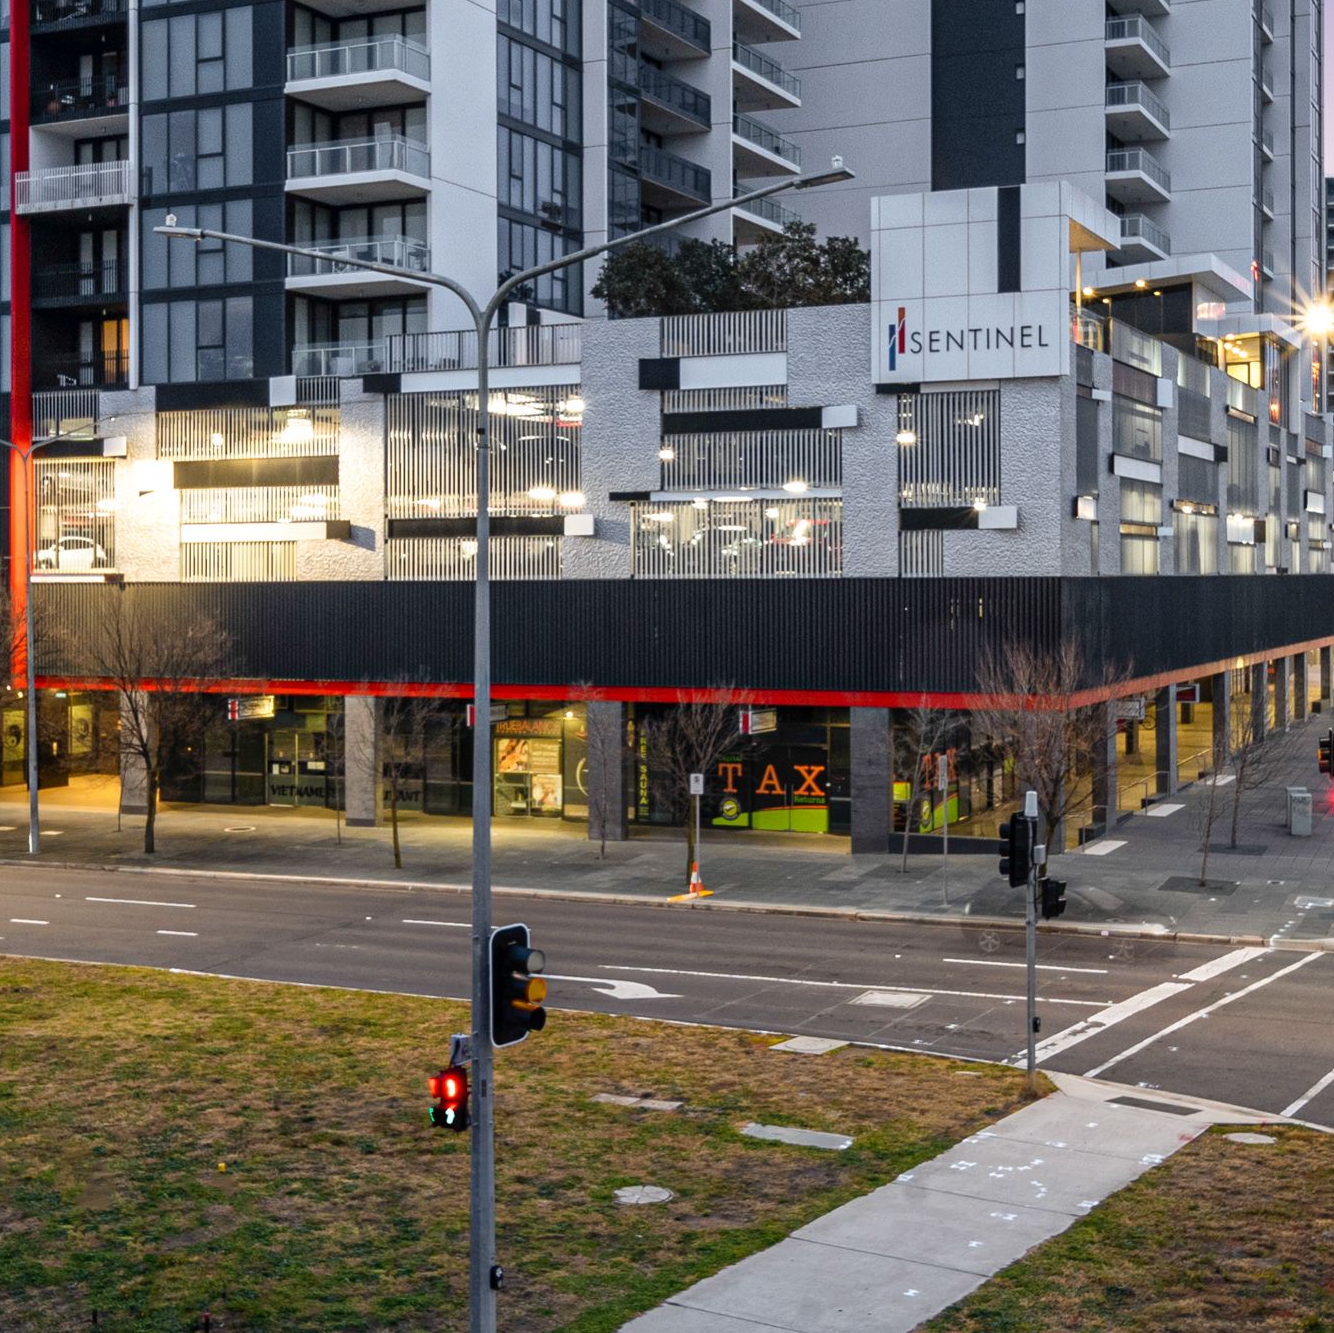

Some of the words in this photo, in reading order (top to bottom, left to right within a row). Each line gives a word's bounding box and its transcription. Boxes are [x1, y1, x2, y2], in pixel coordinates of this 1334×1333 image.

[910, 324, 1049, 354] SENTINEL
[639, 765, 648, 804] SAUNA
[718, 763, 826, 796] TAX
[794, 795, 826, 804] Returns
